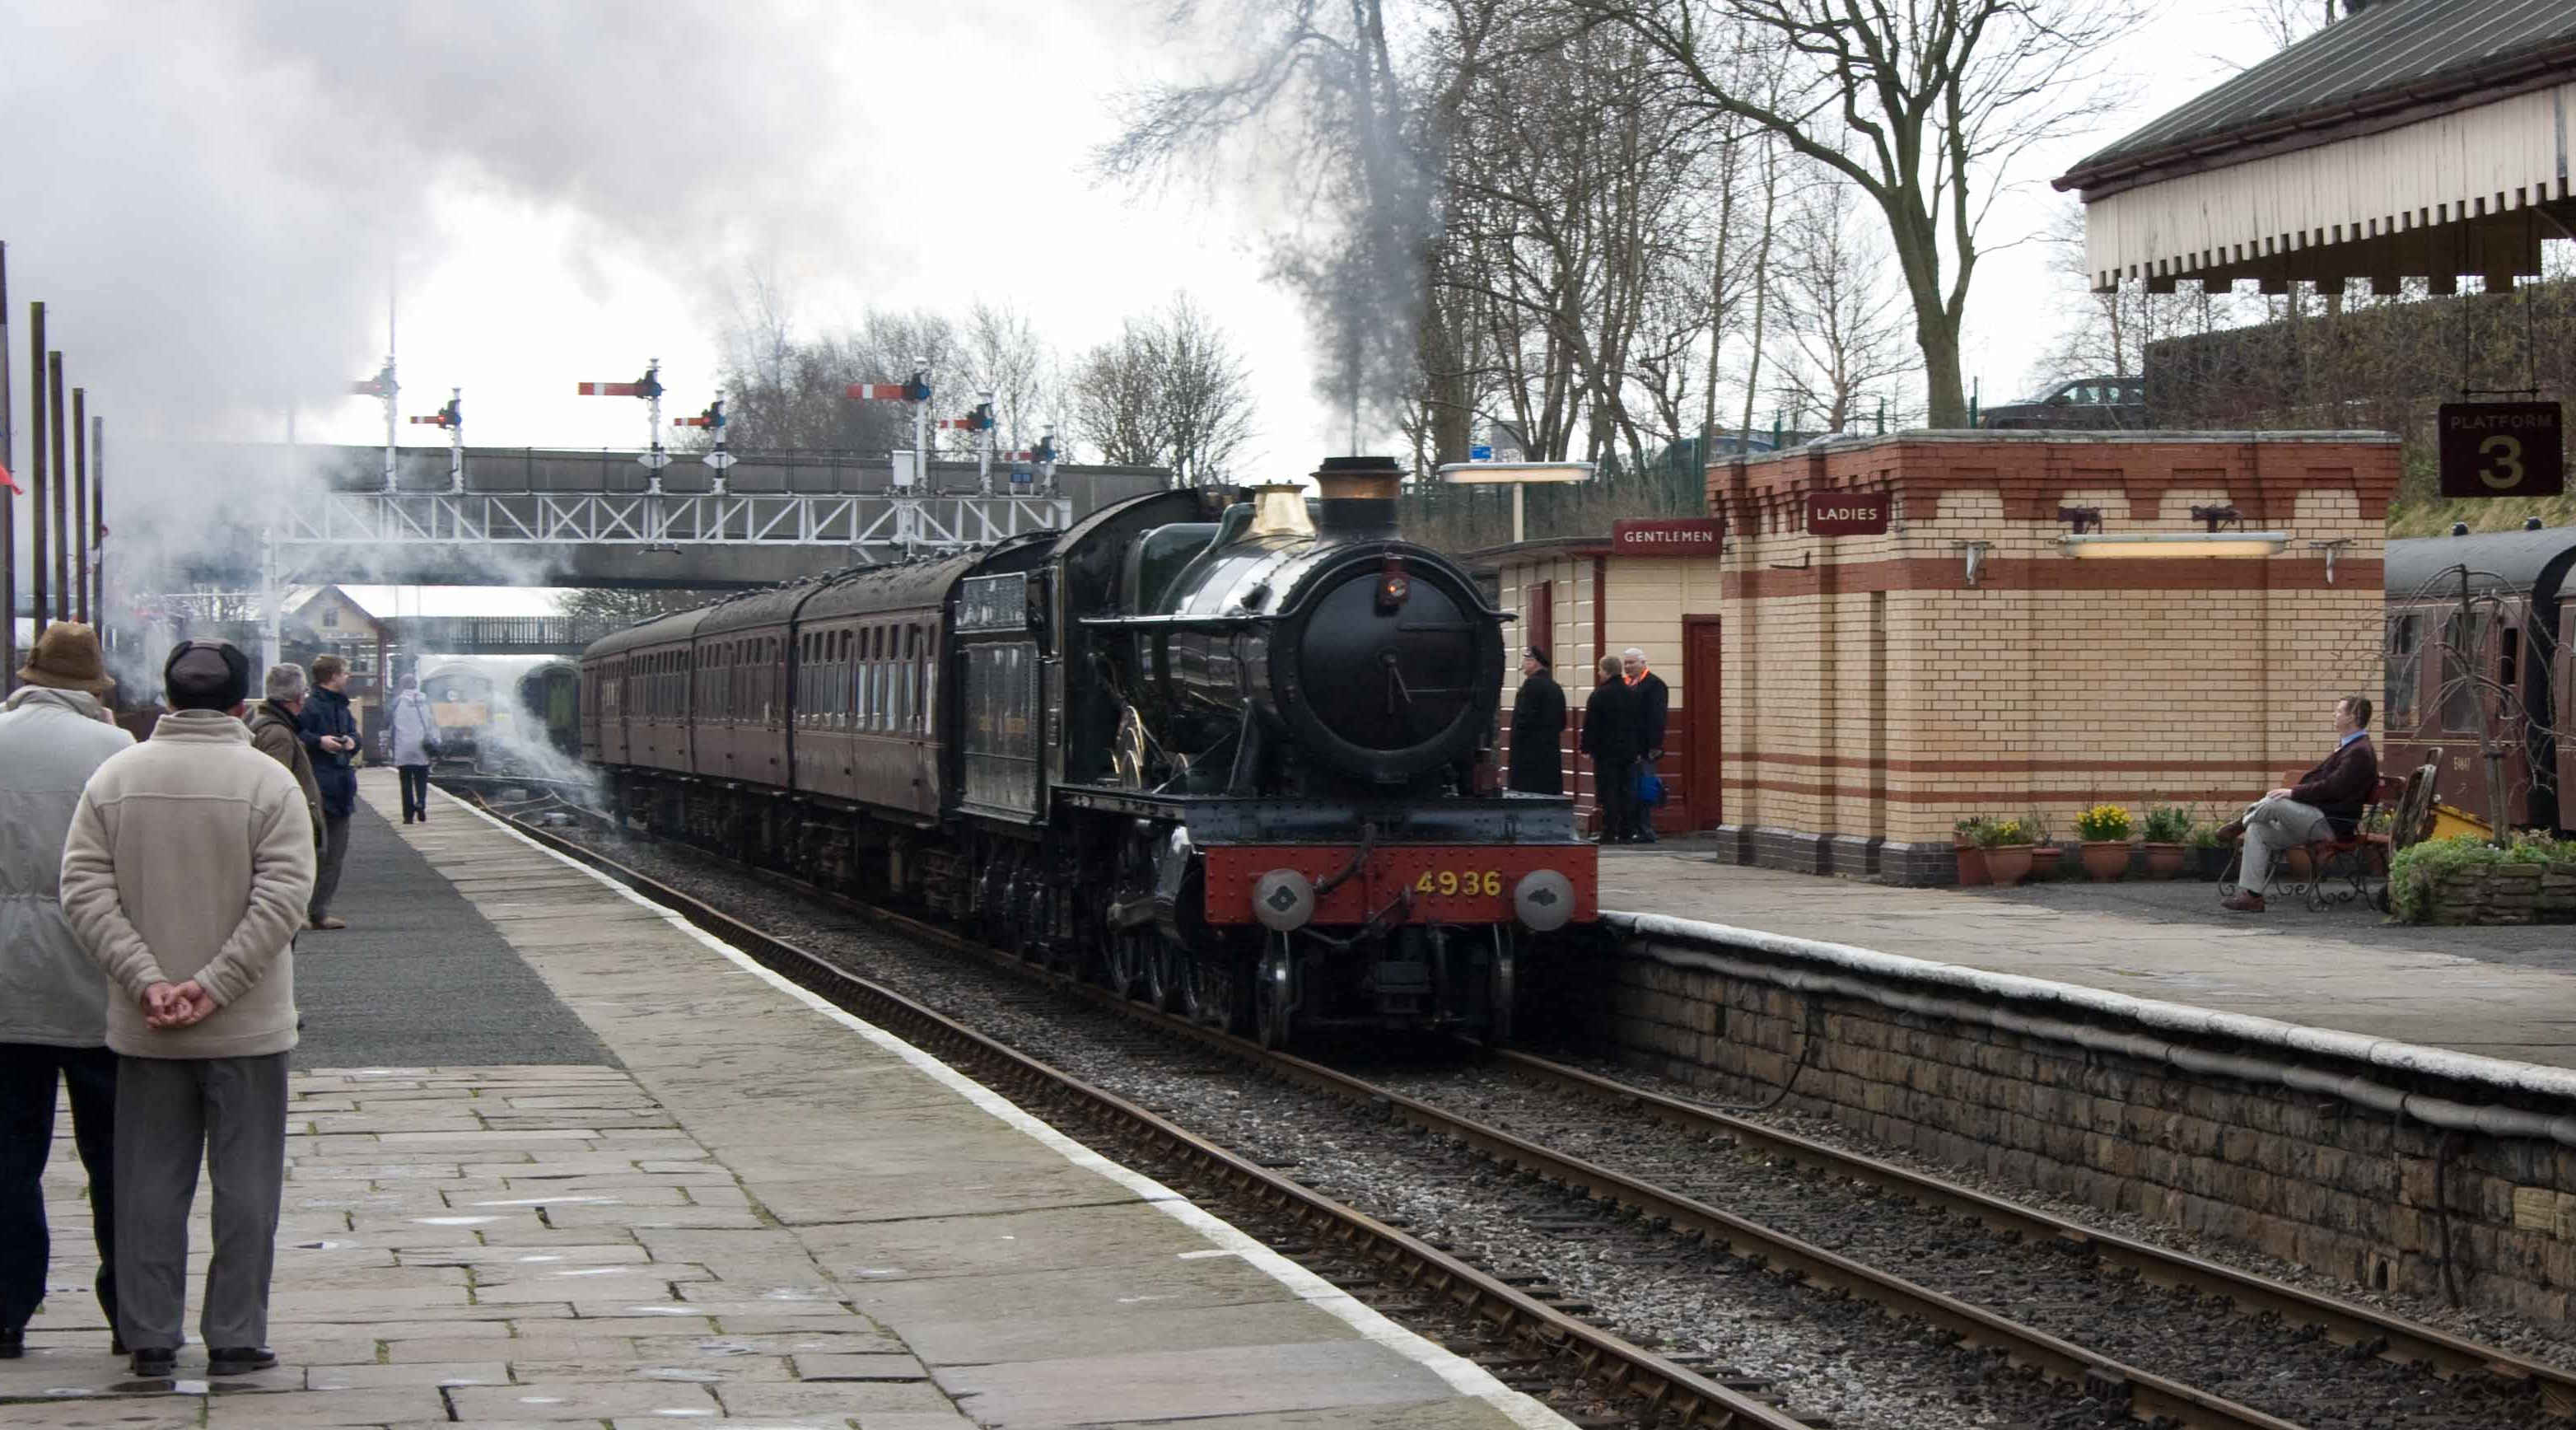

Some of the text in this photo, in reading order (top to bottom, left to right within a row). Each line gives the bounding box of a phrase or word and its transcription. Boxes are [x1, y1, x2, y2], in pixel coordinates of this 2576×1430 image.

[2451, 414, 2553, 429] PLATFORM
[2479, 434, 2523, 489] 3
[1817, 507, 1878, 521] LADIES
[1624, 530, 1713, 542] GENTLEMEN
[1416, 870, 1501, 896] 4936
